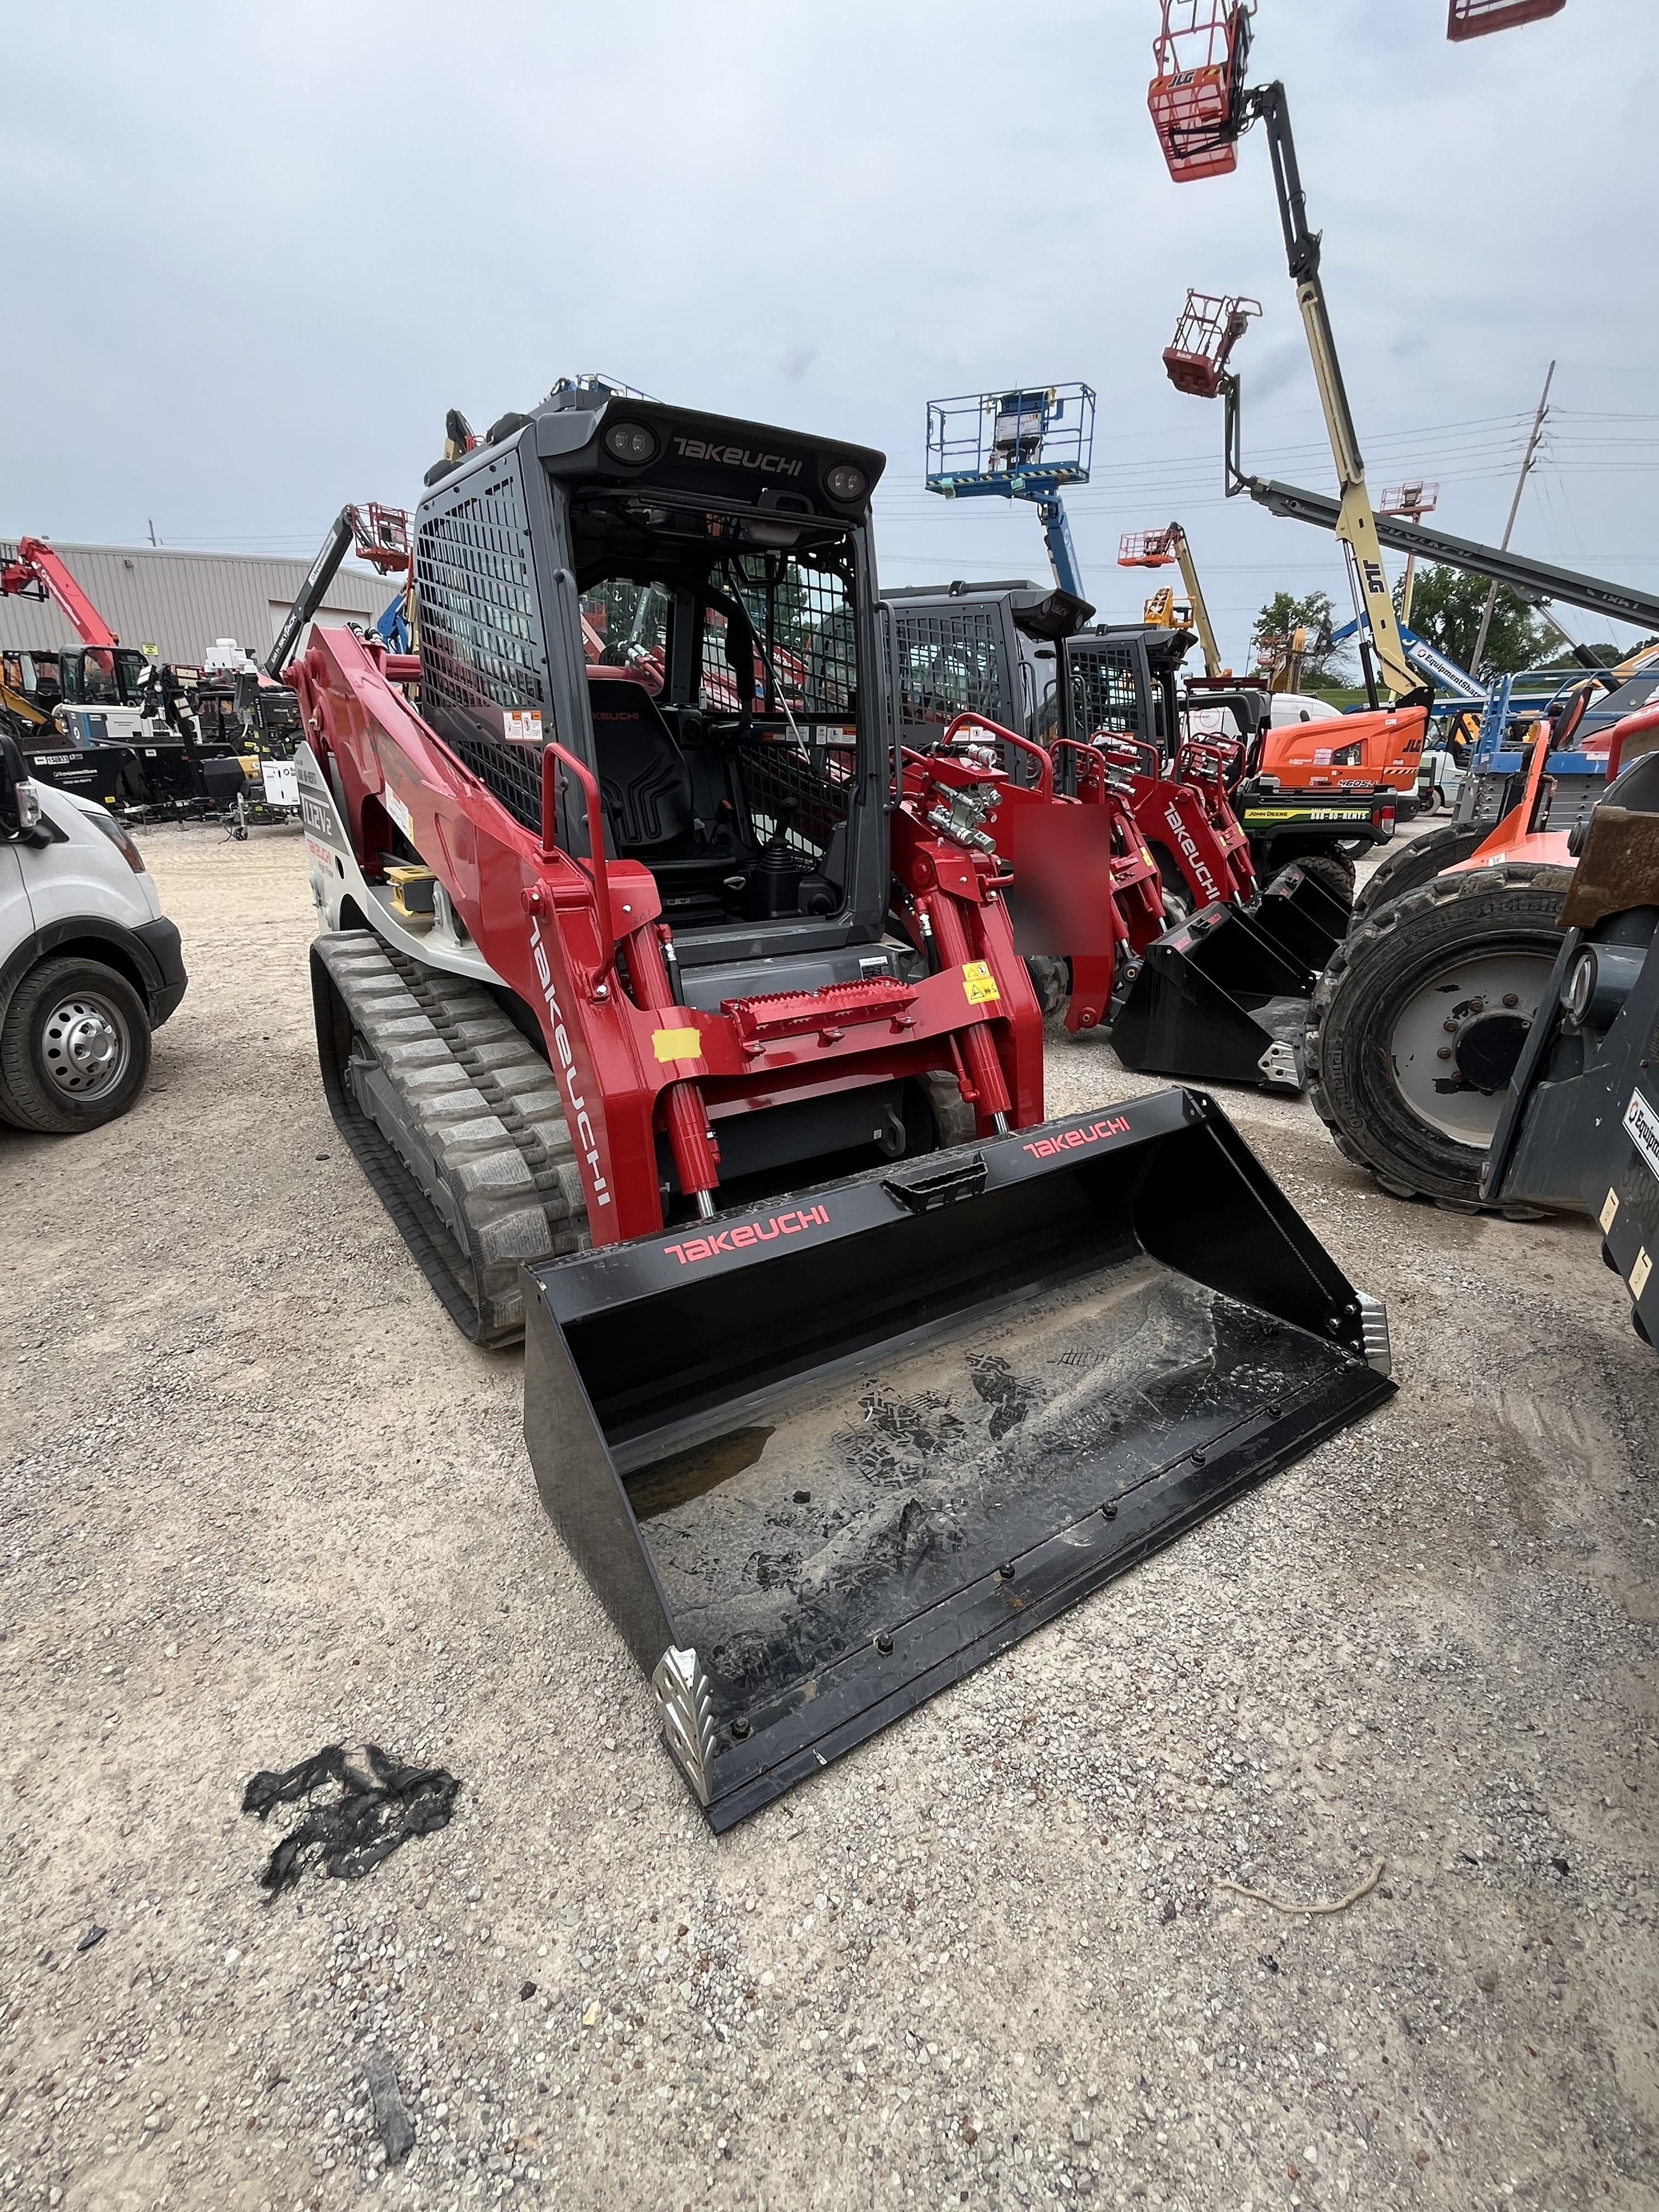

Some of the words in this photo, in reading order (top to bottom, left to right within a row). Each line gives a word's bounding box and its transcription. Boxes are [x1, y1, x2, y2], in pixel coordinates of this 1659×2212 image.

[1167, 71, 1195, 88] JLG
[673, 436, 803, 476] TAKEUCHI
[1363, 560, 1385, 593] JLG
[278, 614, 297, 650] SKYJACK
[1425, 654, 1482, 697] EquipmentShare
[592, 712, 640, 720] KEUCHI
[1310, 812, 1367, 820] 888-80-RENTS
[1164, 801, 1221, 900] TAKEUCHI
[529, 915, 611, 1206] TAKEUCHI
[1023, 1115, 1131, 1159] TAKEUCHI
[1635, 1109, 1659, 1161] Equipm
[664, 1205, 830, 1264] TAKEUCHI
